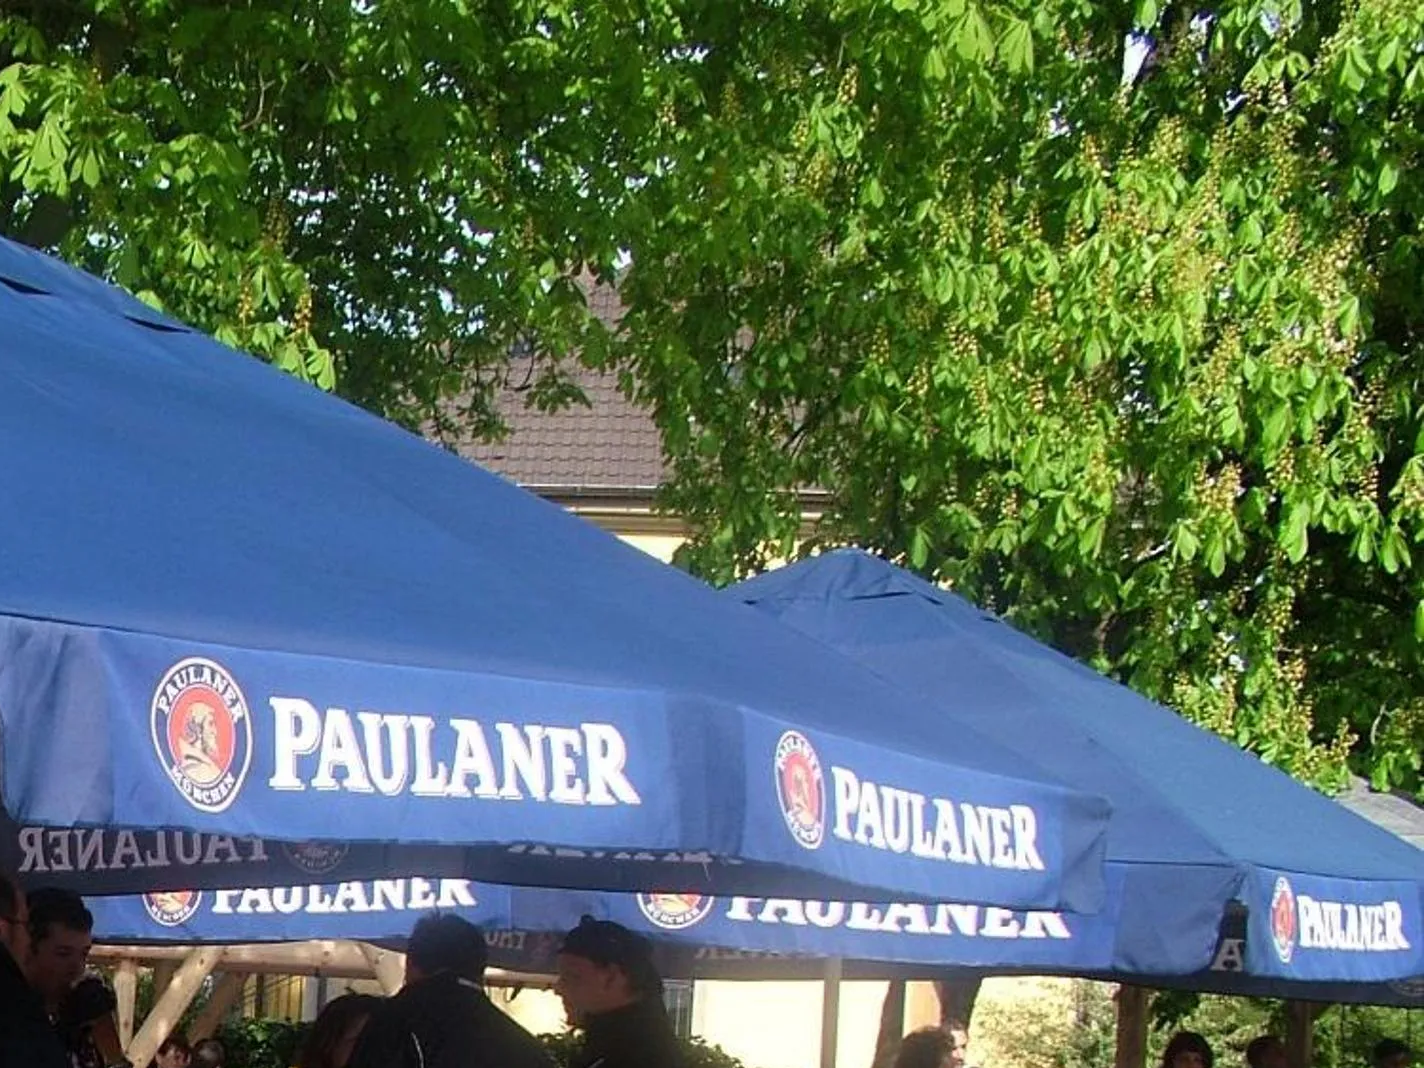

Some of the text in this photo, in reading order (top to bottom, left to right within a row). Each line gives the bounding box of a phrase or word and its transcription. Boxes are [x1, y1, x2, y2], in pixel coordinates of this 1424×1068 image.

[156, 665, 244, 723] PAULANER
[269, 696, 641, 806] PAULANER
[831, 766, 1045, 870] PAULANER
[1296, 895, 1412, 951] PAULANER
